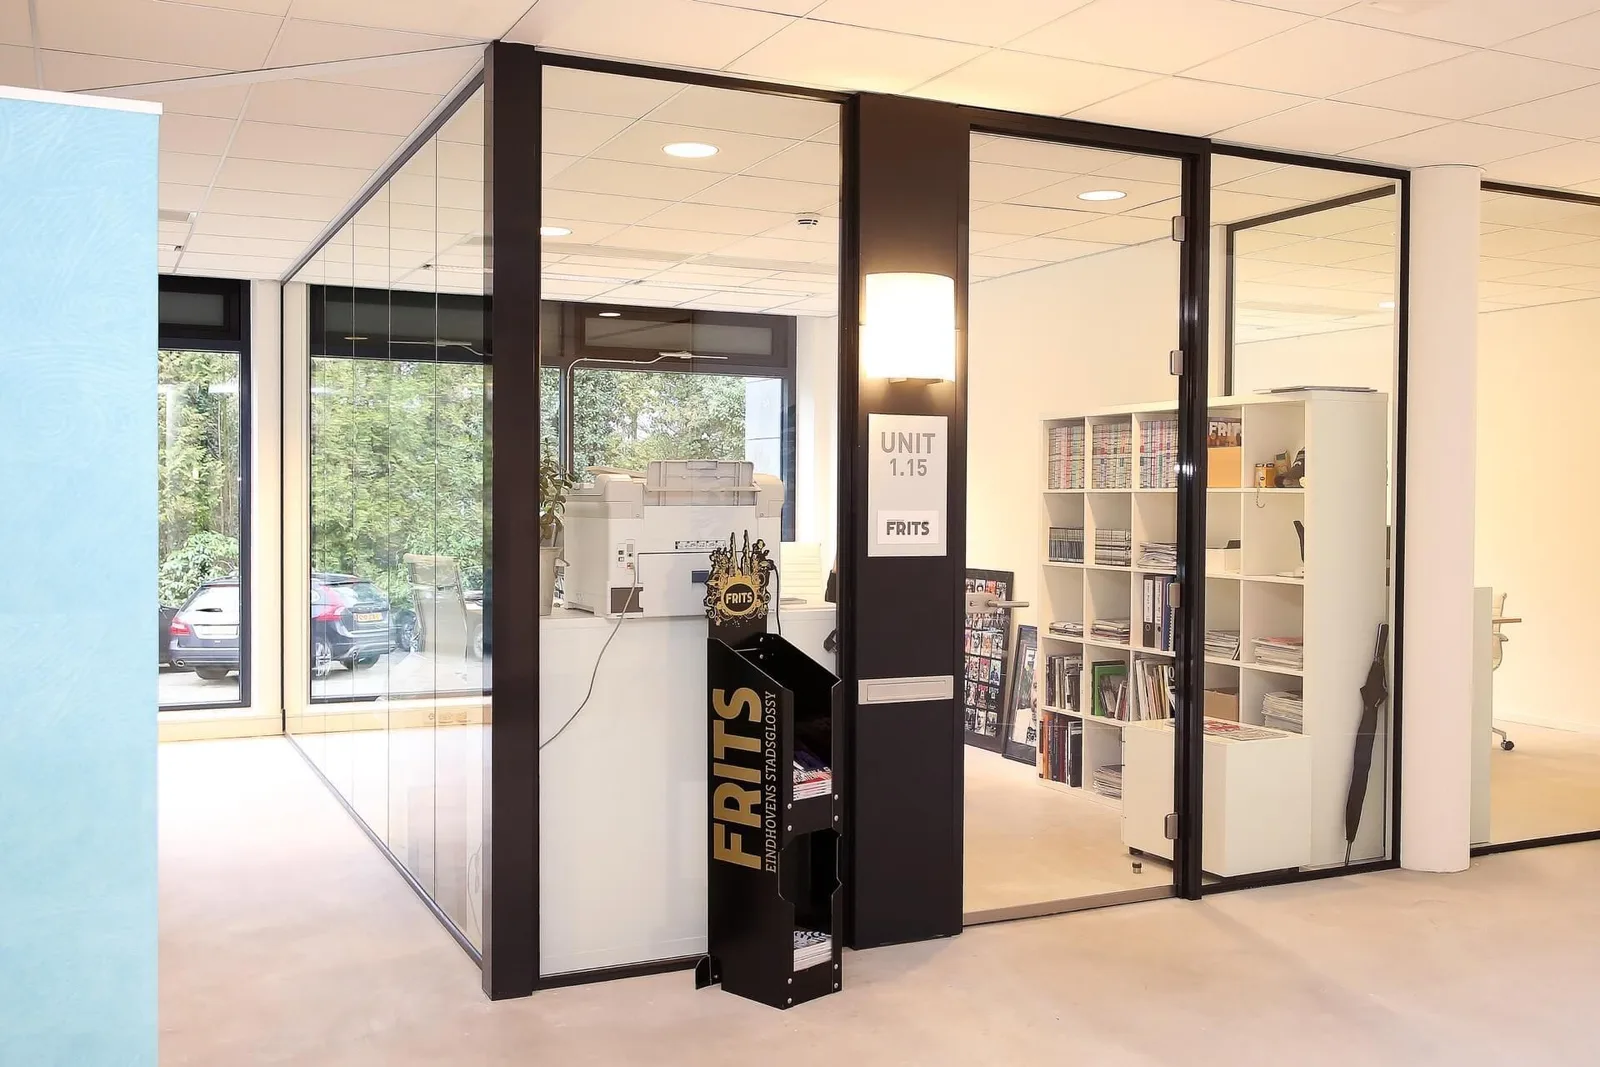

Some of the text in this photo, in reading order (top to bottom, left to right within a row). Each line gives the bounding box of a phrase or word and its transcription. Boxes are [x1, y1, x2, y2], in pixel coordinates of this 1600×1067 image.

[1209, 421, 1241, 437] FRIT
[881, 432, 936, 454] UNIT
[890, 458, 928, 477] 1.15
[886, 521, 930, 536] FRITS
[725, 592, 753, 605] FRITS
[712, 687, 763, 870] FRITS
[764, 690, 777, 873] EINDHOVENS STADSGLOSSY
